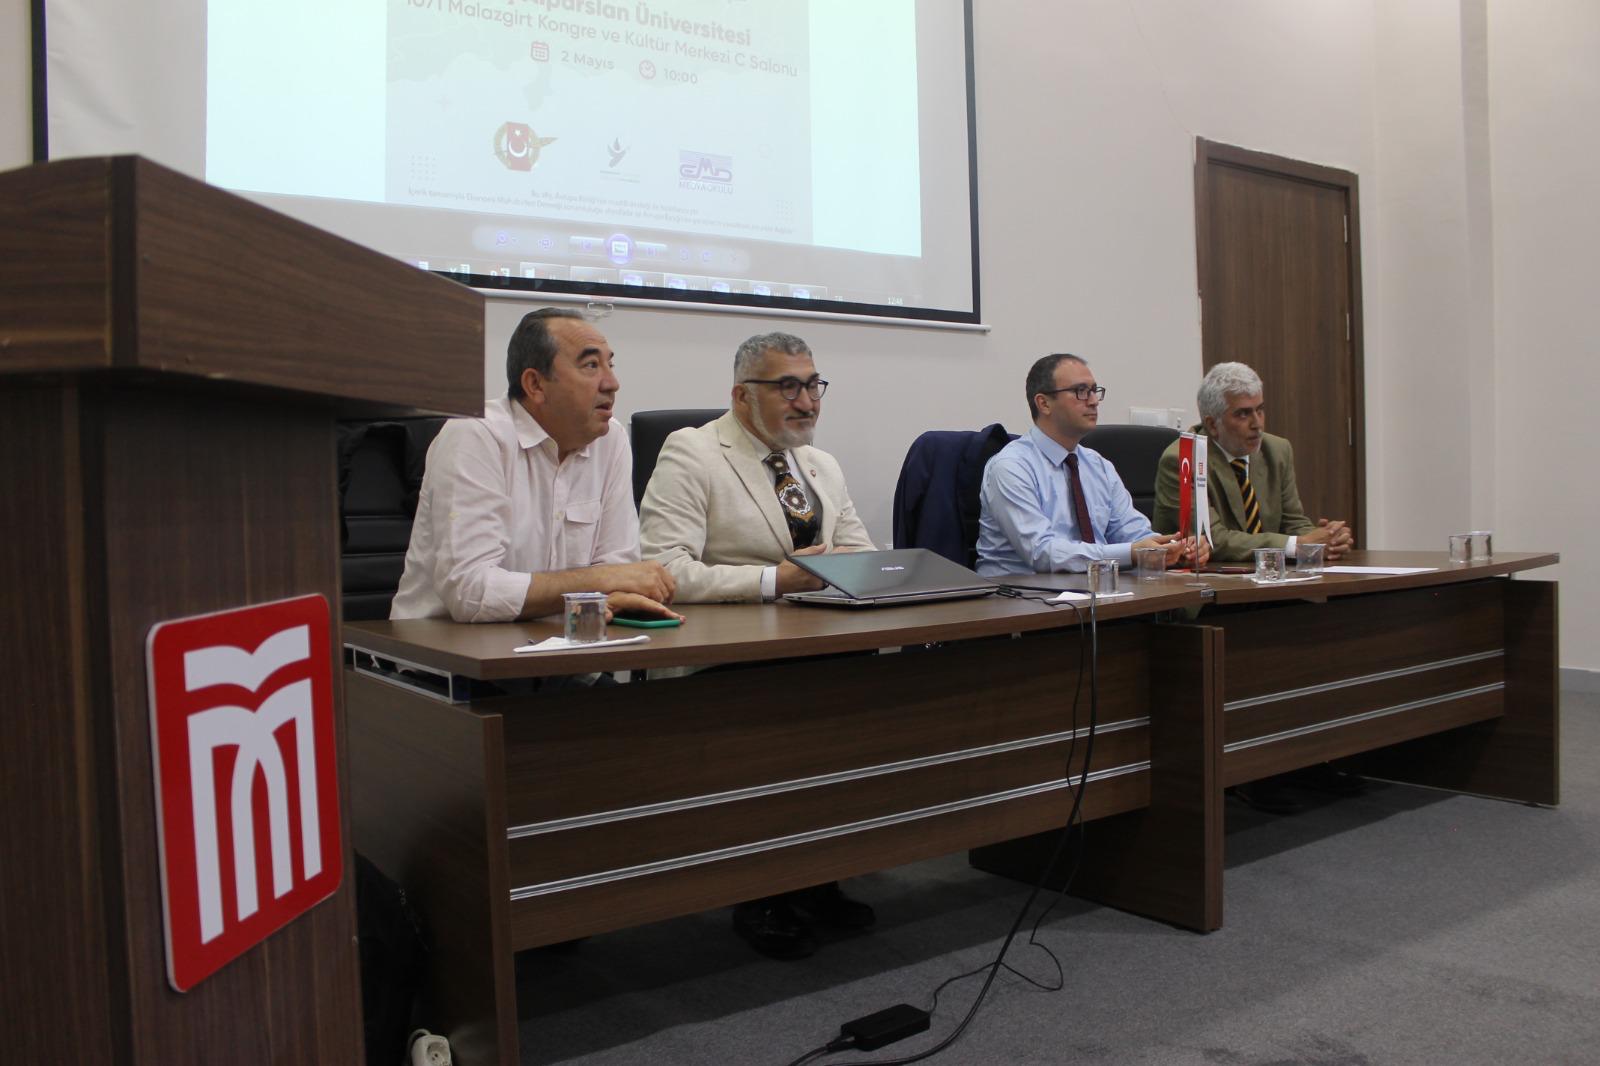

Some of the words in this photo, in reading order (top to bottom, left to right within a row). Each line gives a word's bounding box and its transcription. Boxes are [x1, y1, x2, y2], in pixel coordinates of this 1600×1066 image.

[448, 0, 533, 27] Malazgirt
[538, 14, 597, 39] Kongre
[601, 29, 620, 43] ve
[625, 30, 671, 52] Kültür
[674, 40, 730, 64] Merkezi
[734, 53, 746, 67] C
[750, 56, 798, 77] Salonu
[522, 0, 629, 22] parslan
[635, 2, 752, 47] Üniversitesi
[560, 50, 569, 62] 2
[663, 68, 698, 84] 10:00
